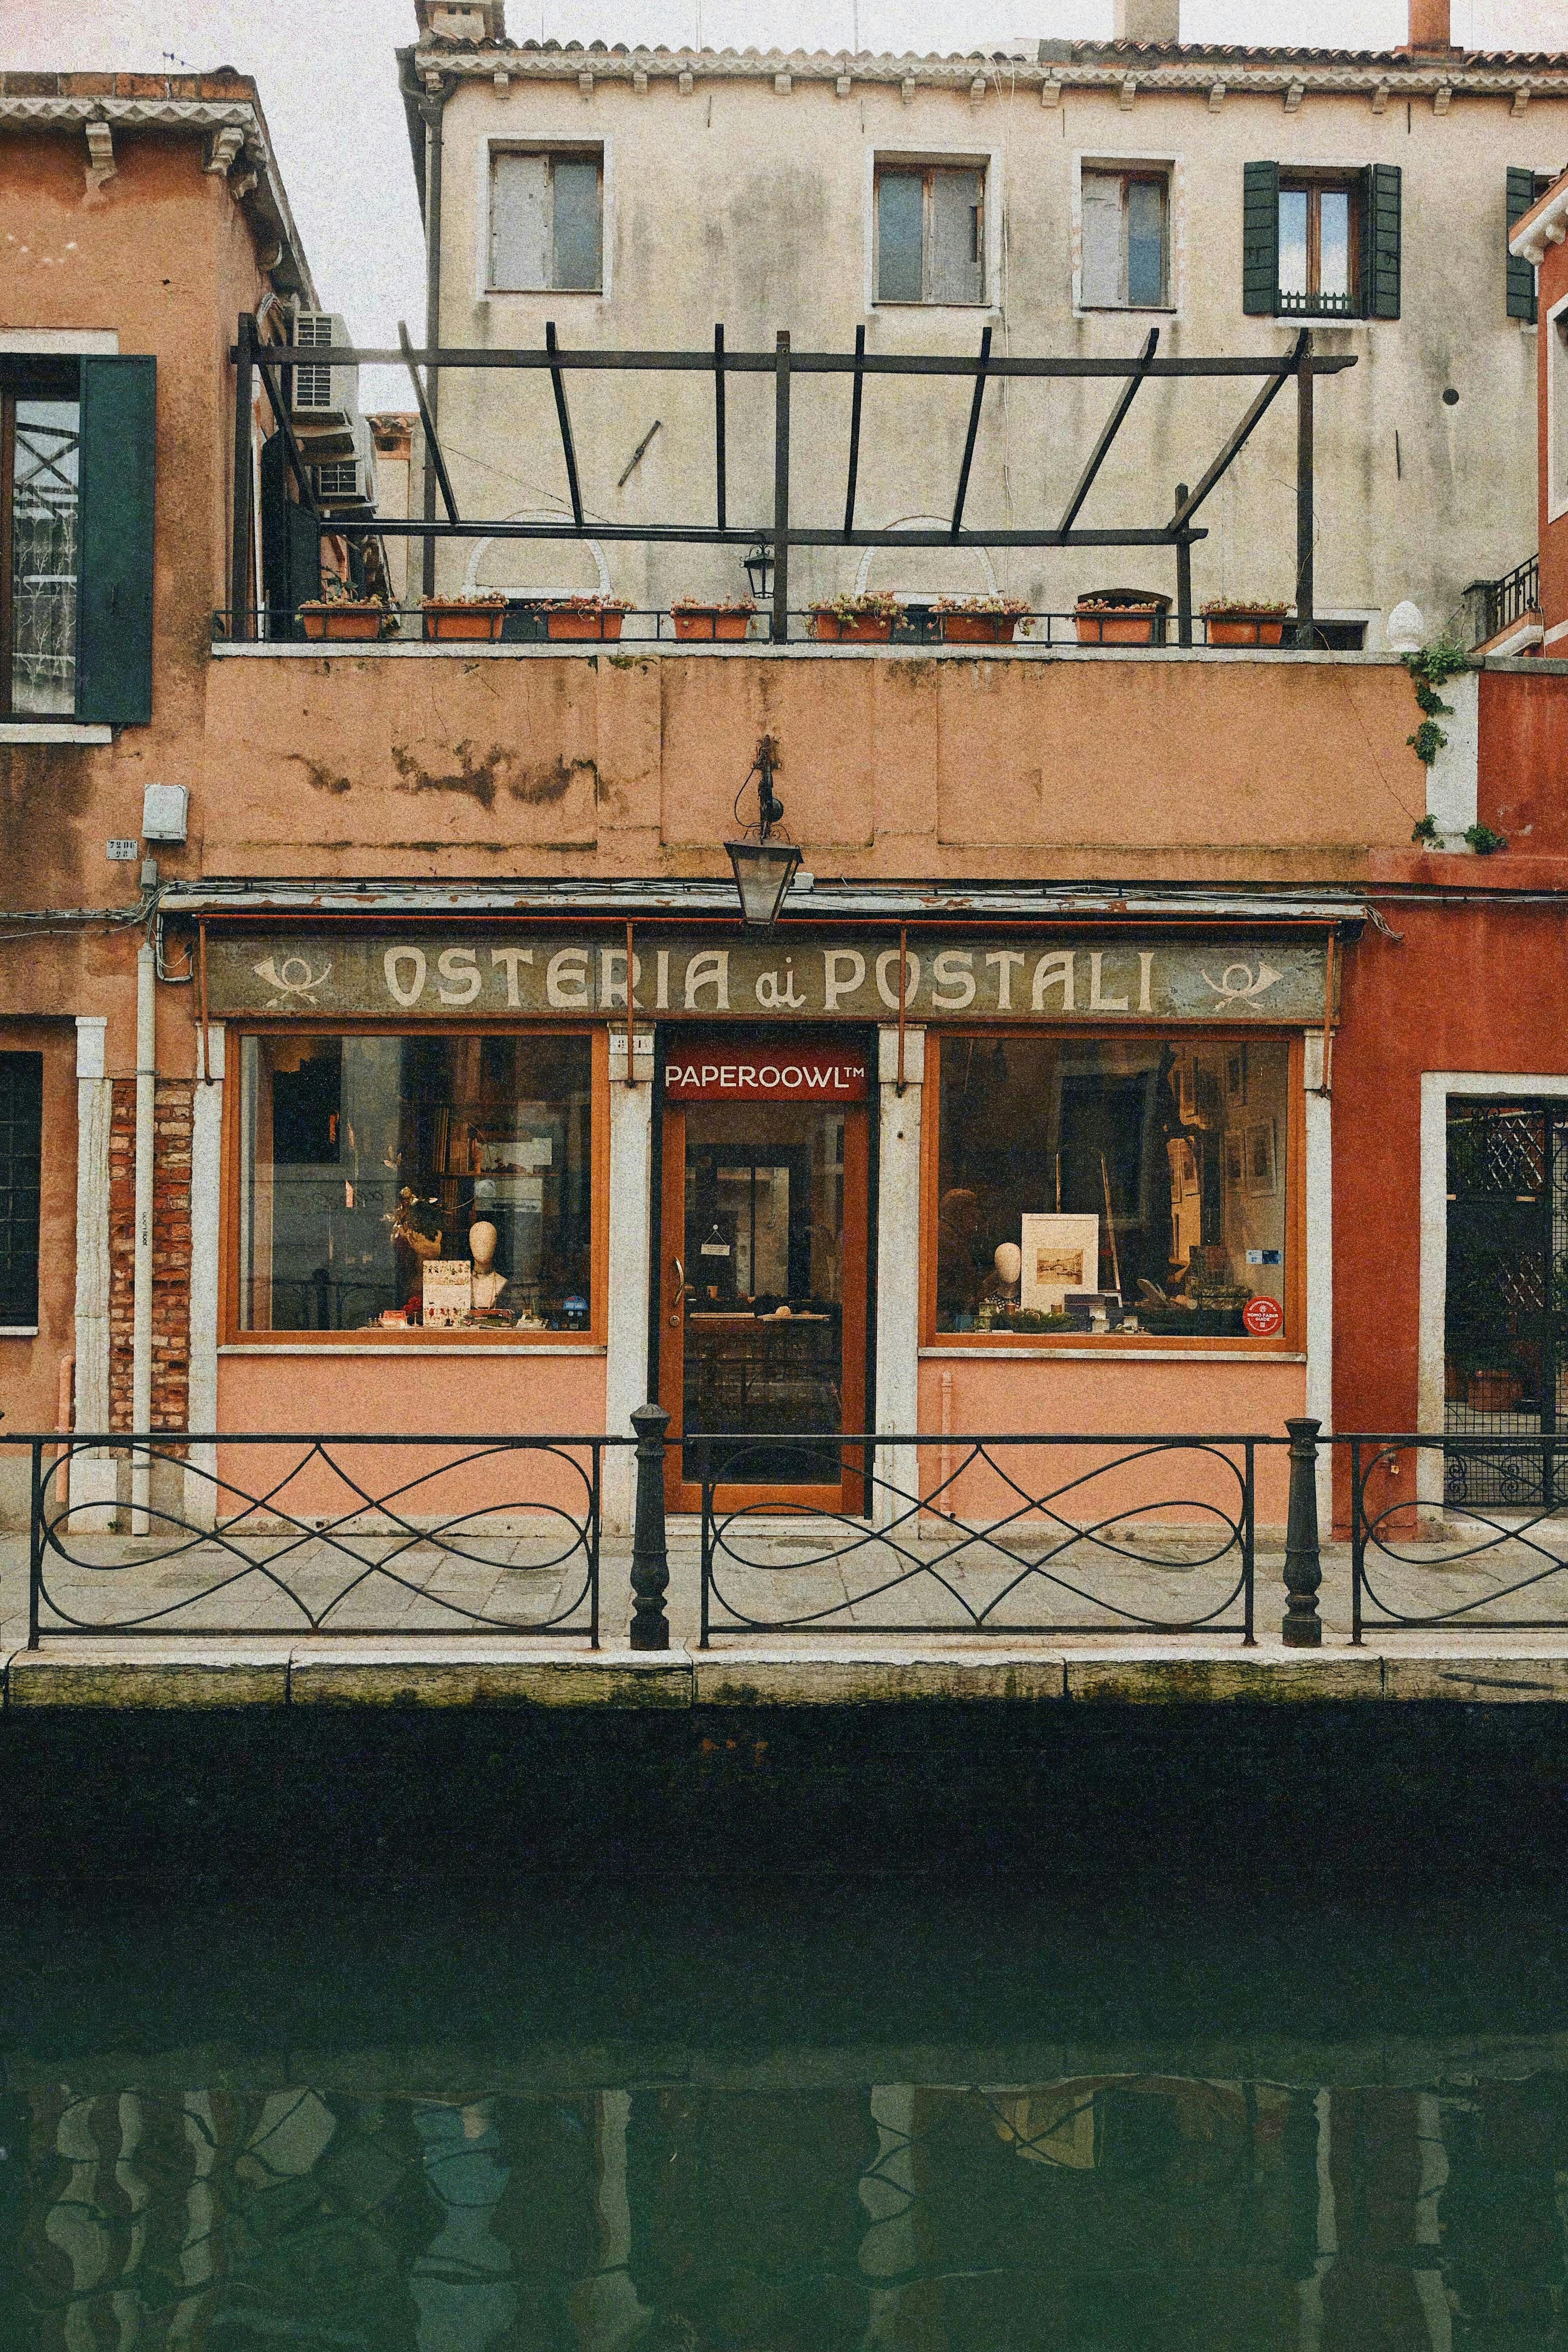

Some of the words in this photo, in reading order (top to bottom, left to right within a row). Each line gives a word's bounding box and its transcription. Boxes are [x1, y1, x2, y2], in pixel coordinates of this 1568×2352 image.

[383, 945, 730, 1009] OSTERIA
[755, 956, 807, 1008] ai
[822, 948, 1156, 1013] POSTALI
[618, 1040, 641, 1049] 81
